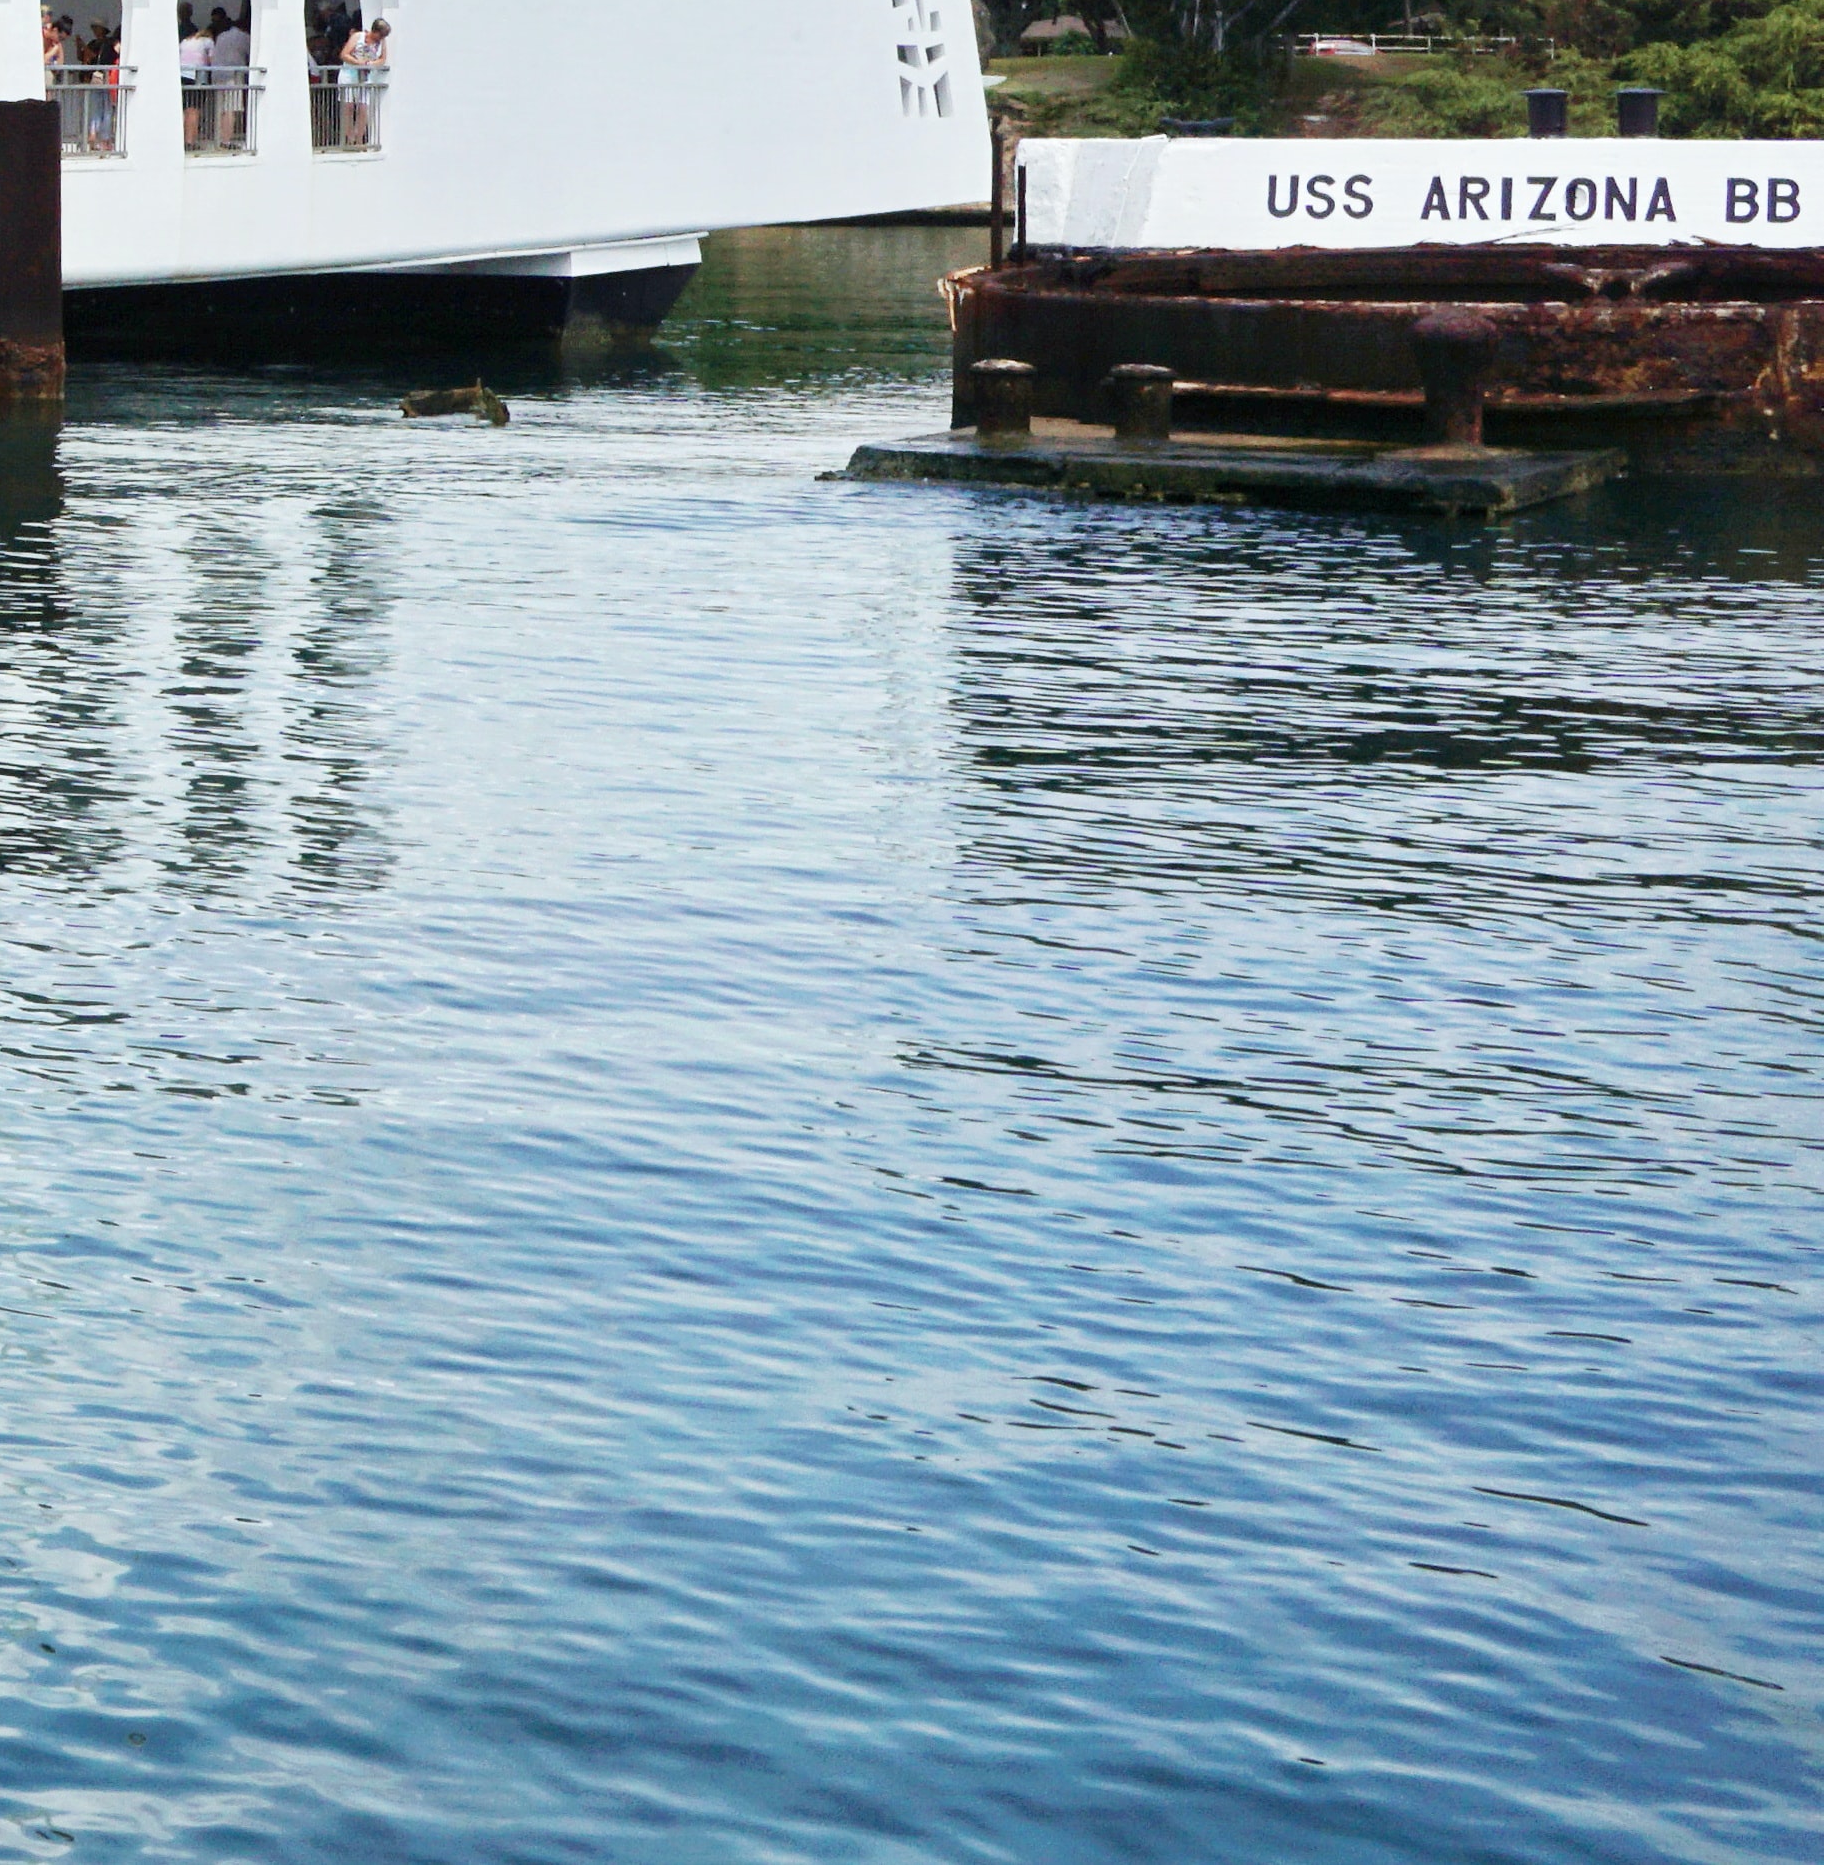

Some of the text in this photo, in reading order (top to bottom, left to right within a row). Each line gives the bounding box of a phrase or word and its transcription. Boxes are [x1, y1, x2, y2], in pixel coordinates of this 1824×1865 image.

[1267, 174, 1801, 224] USS ARIZONA BB
